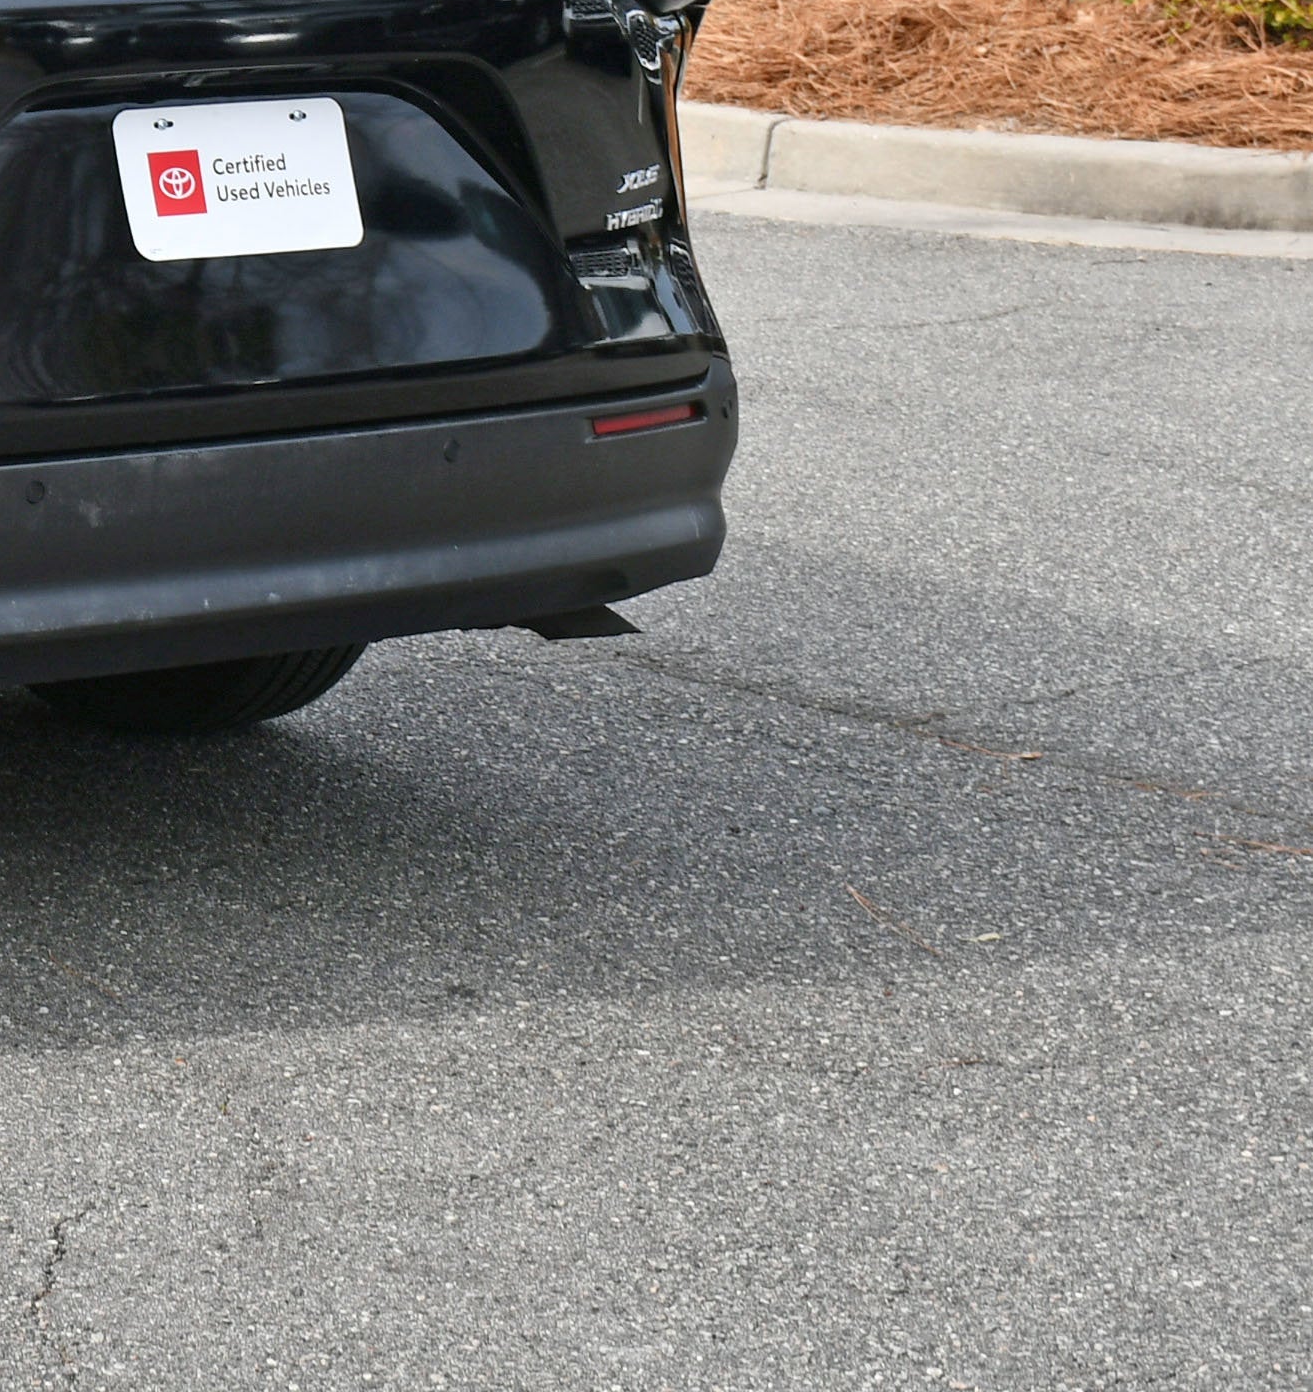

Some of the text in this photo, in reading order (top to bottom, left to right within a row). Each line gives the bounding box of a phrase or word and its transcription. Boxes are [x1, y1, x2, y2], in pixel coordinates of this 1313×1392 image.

[212, 152, 287, 175] Certified
[216, 178, 330, 202] Used Vehicles
[606, 198, 664, 232] HYBRID
